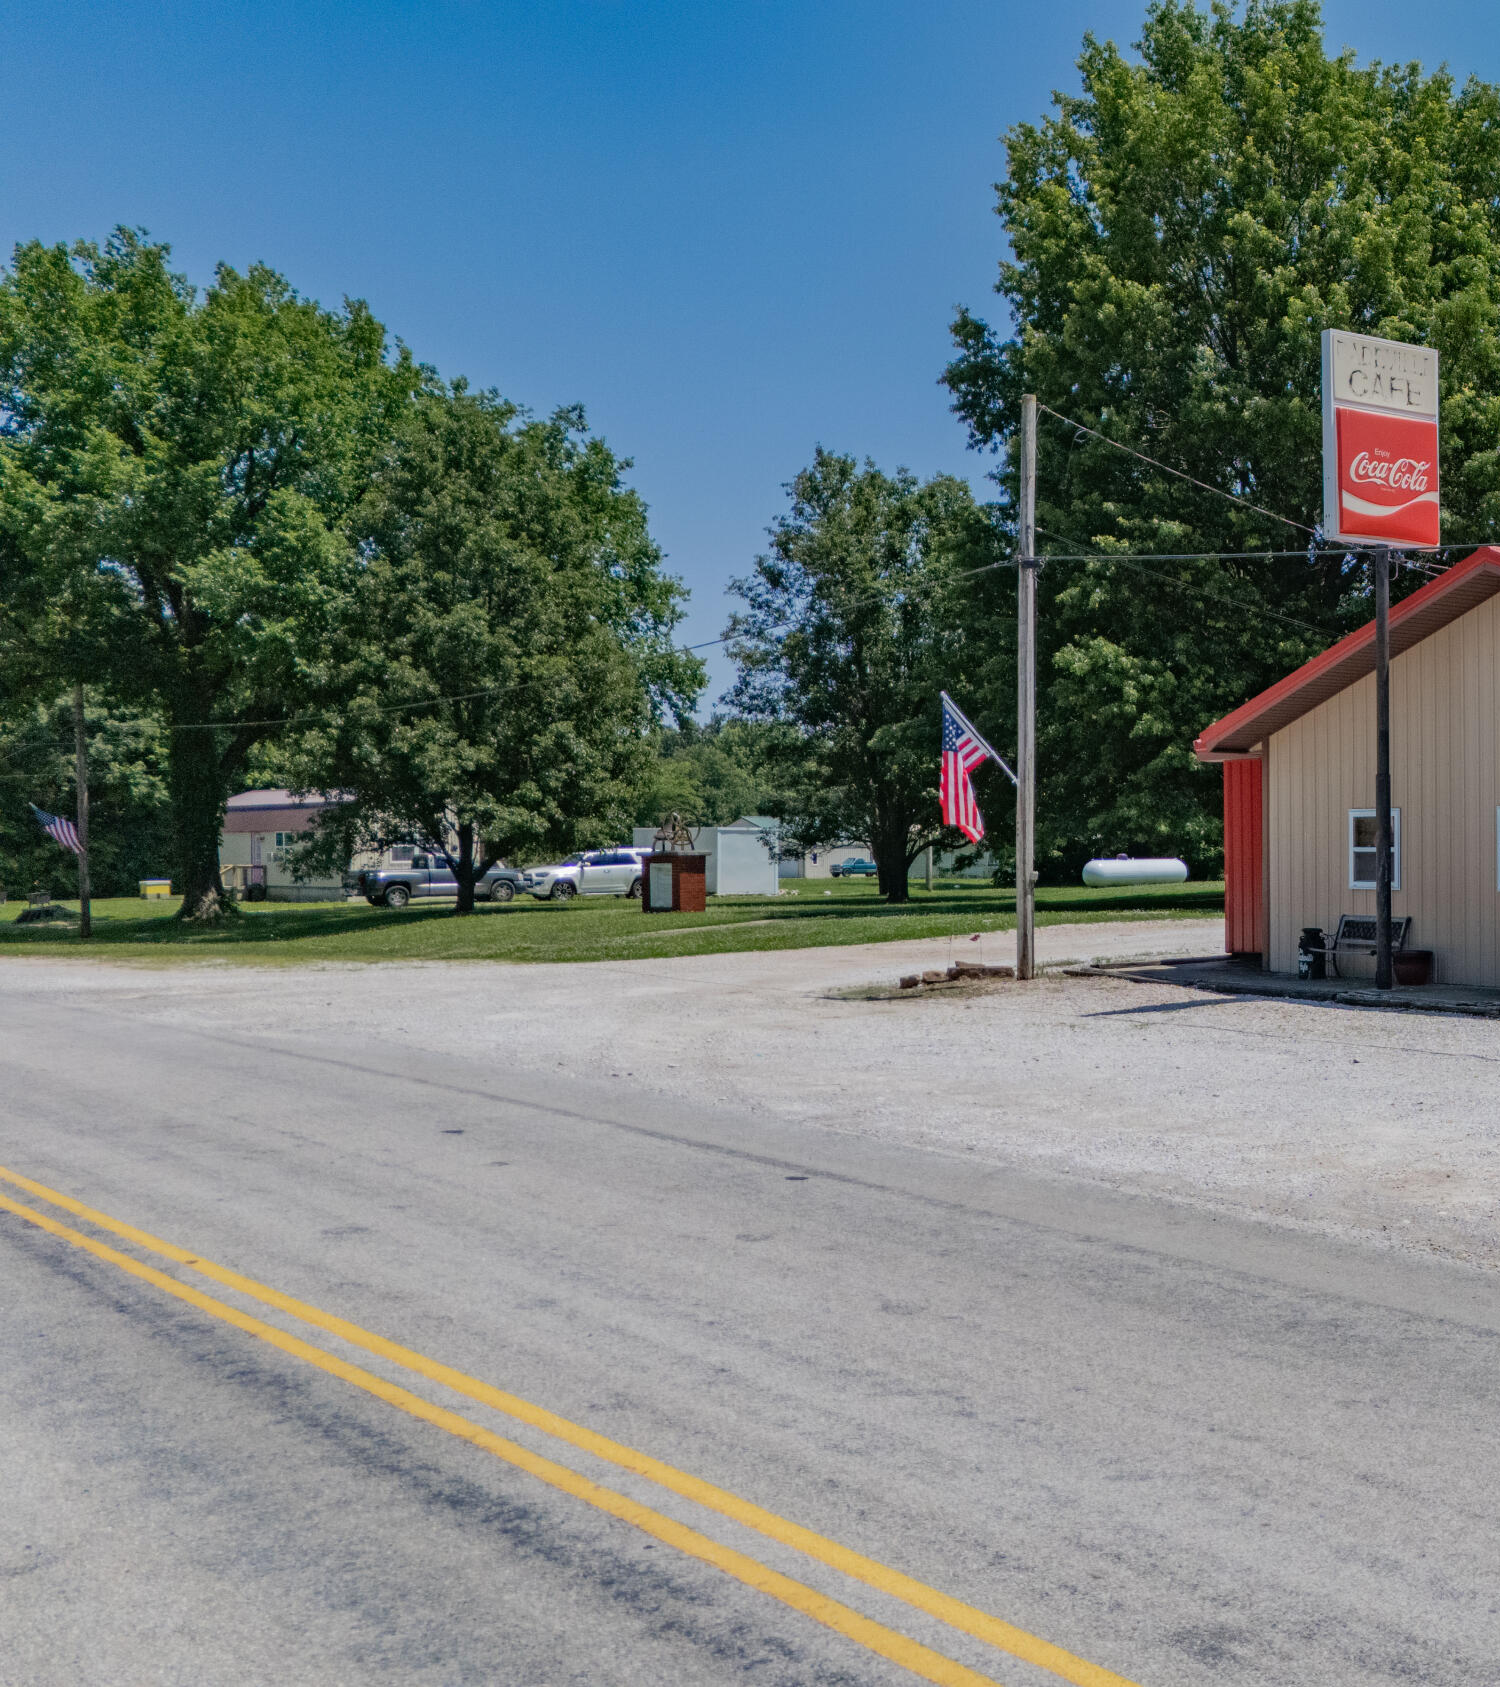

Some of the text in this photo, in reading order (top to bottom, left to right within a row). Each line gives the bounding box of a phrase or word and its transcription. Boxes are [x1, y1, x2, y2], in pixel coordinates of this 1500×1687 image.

[1349, 369, 1421, 406] CAFE
[1374, 447, 1391, 458] Enjoy
[1349, 451, 1432, 492] Coca-Cola
